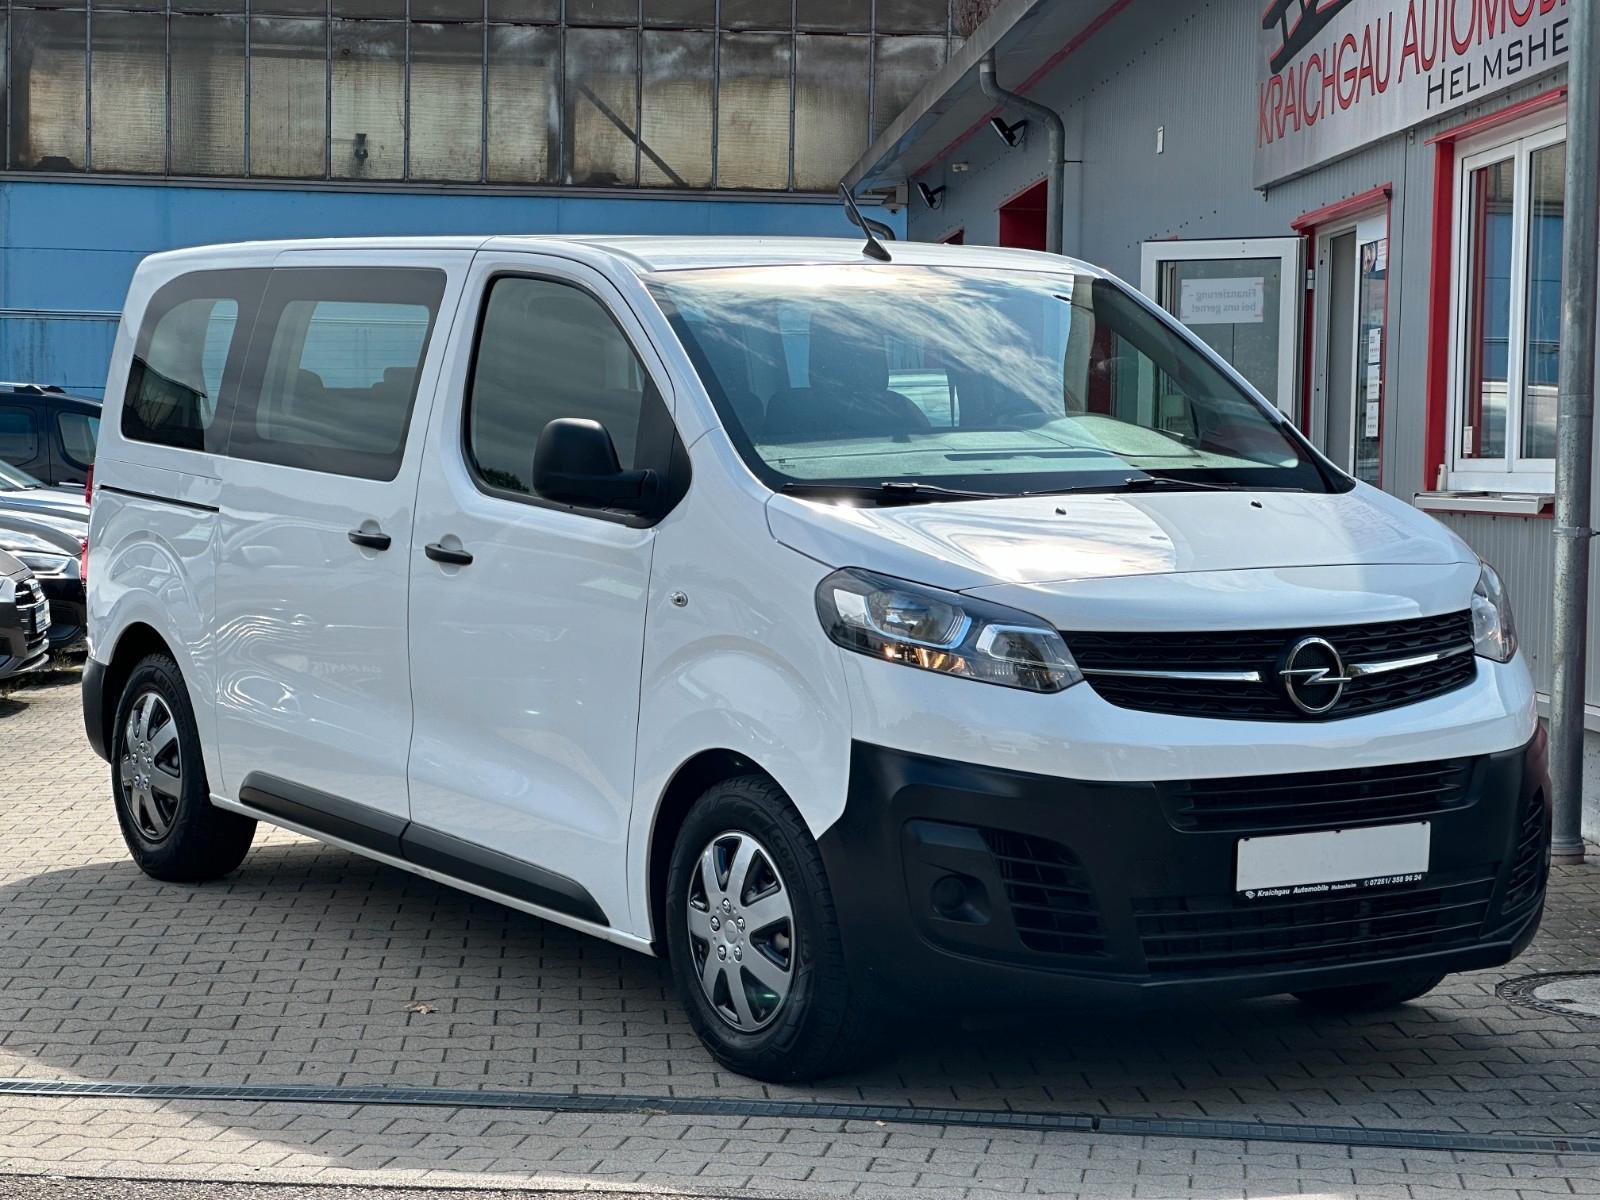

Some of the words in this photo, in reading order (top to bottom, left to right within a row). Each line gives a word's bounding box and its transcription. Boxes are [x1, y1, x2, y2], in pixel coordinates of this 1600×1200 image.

[1257, 11, 1394, 148] KRAICHGAU
[1398, 0, 1567, 84] AUTOM
[1426, 18, 1568, 110] HELMSHE
[1257, 888, 1290, 898] Kraichgau
[1293, 884, 1329, 894] Automobile
